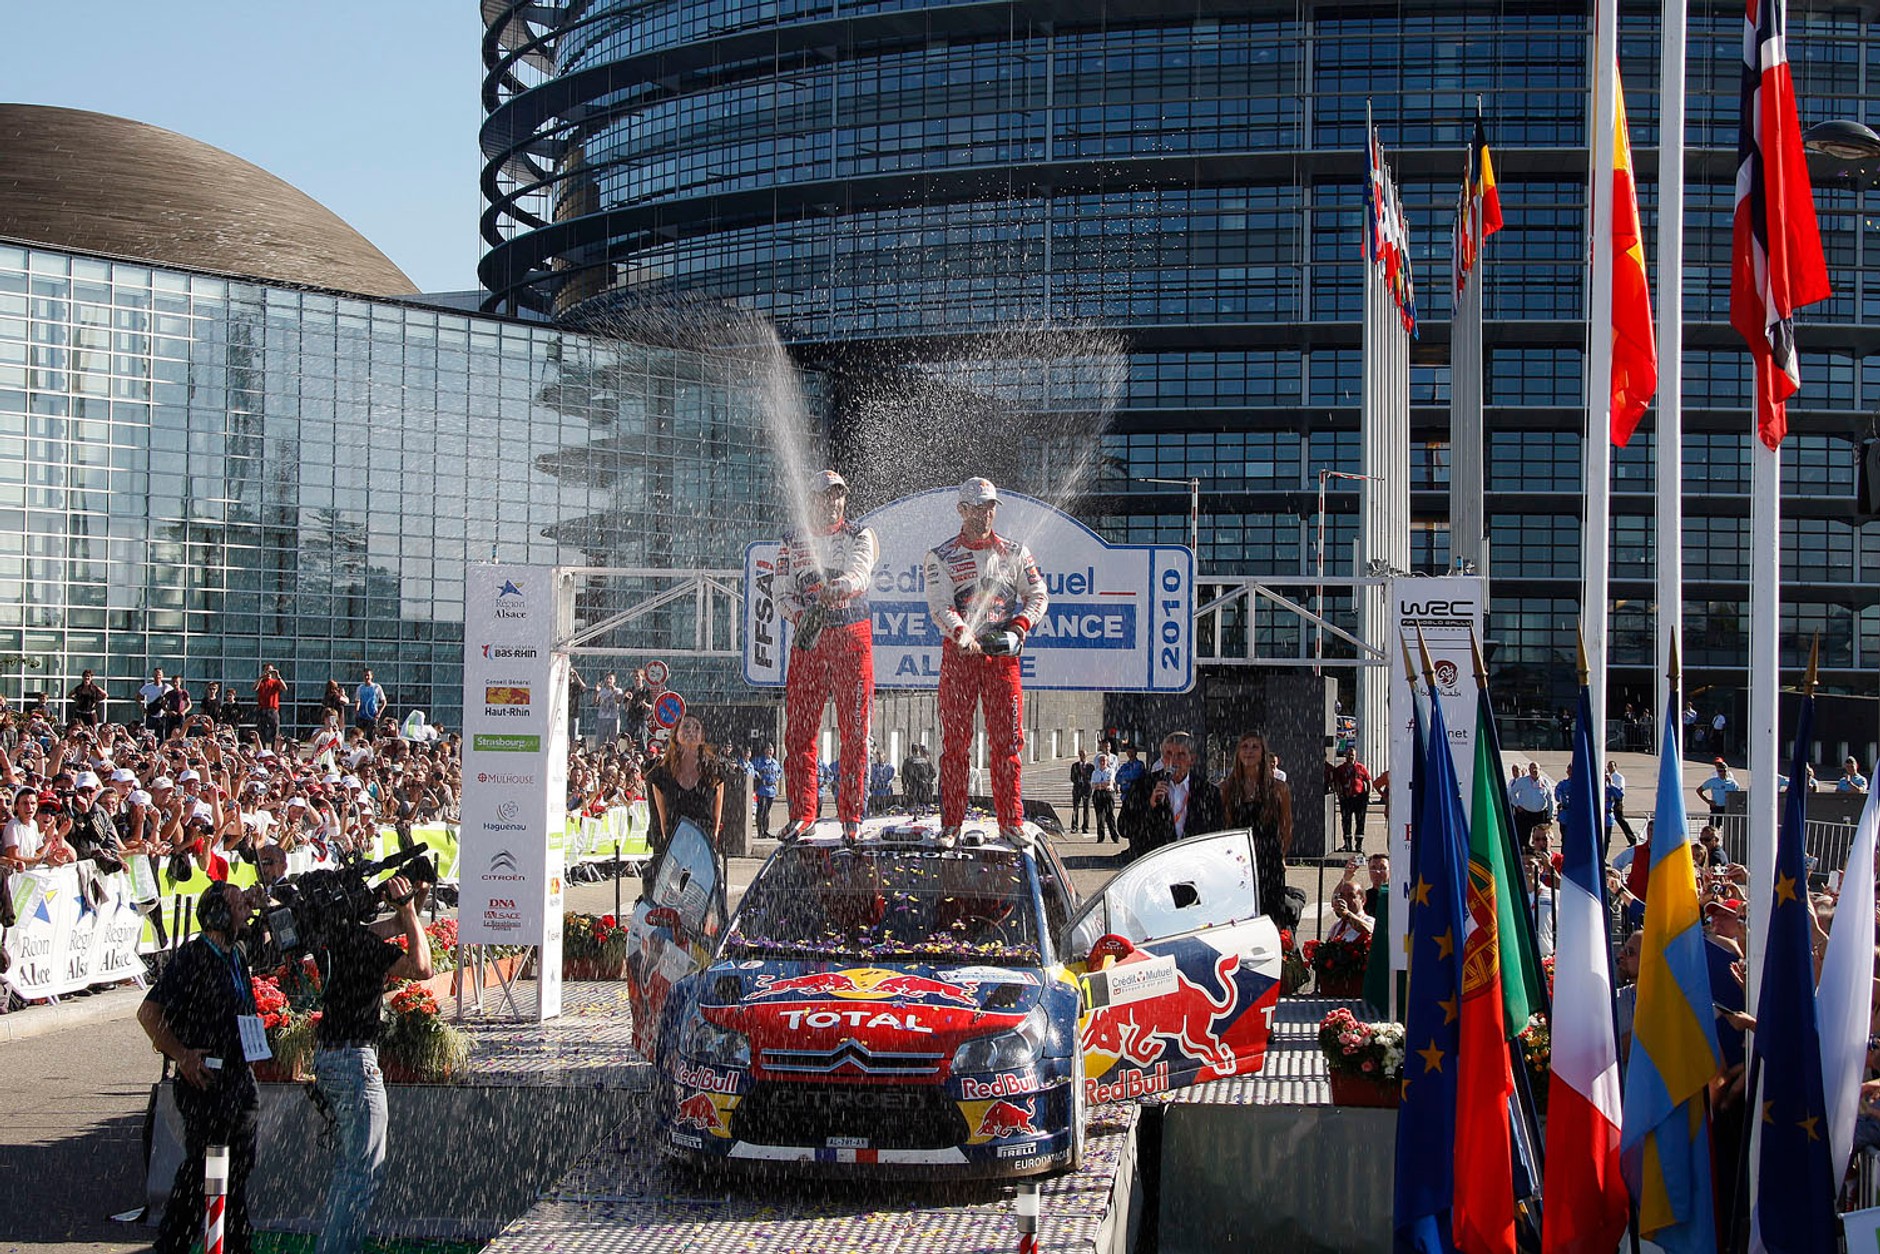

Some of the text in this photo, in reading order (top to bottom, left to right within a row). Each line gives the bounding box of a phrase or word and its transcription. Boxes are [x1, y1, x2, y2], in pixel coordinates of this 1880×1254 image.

[874, 563, 925, 592] édi
[493, 609, 527, 619] Alsace
[1162, 568, 1181, 671] 2010
[1401, 600, 1474, 616] WRC
[754, 572, 775, 669] FFSA
[872, 612, 927, 636] LYE
[485, 707, 530, 716] Haut-Rhin
[483, 823, 526, 832] Haguenau
[489, 899, 516, 907] DNA
[1112, 966, 1173, 988] Crédit Mutuel
[1081, 977, 1093, 1009] 1
[779, 1011, 933, 1034] TOTAL
[700, 1070, 740, 1094] Bull
[962, 1068, 1039, 1100] Red Bull
[1084, 1060, 1169, 1104] Red Bull
